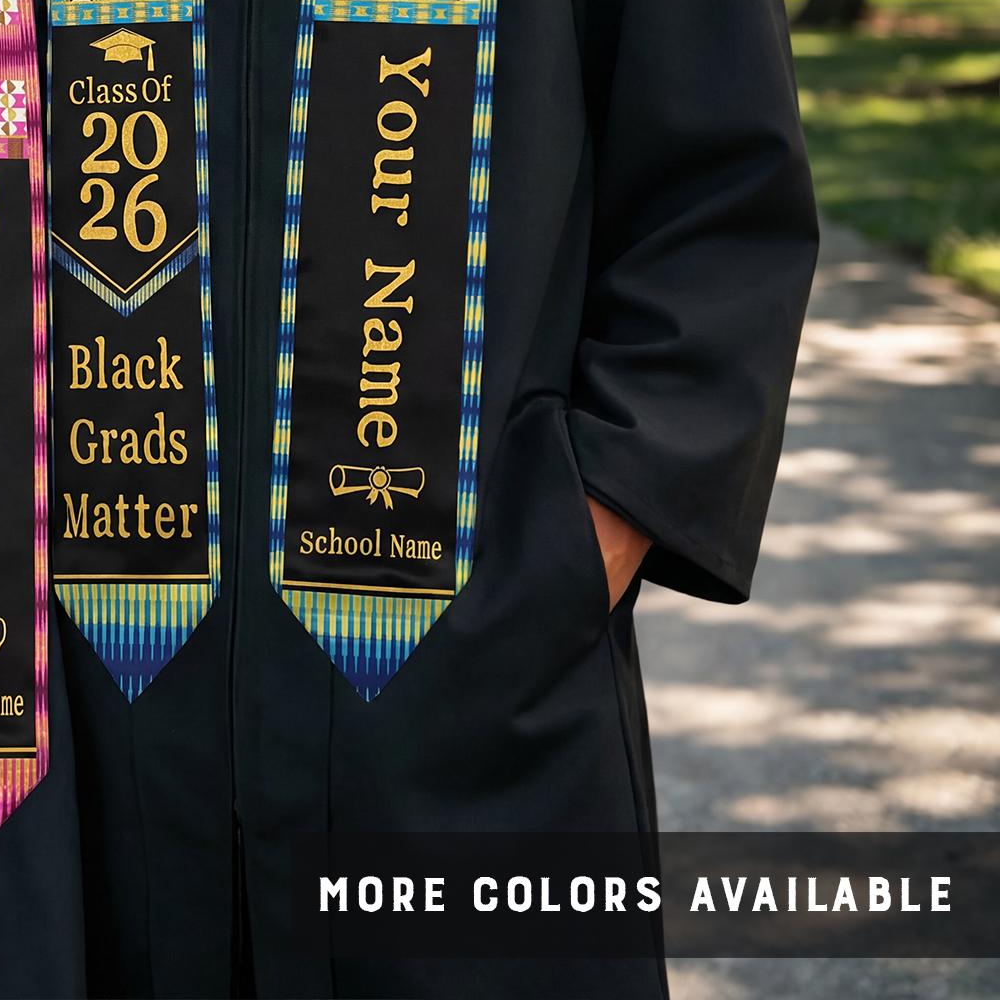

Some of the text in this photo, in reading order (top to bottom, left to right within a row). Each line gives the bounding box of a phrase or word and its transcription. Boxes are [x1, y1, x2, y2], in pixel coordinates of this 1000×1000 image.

[81, 111, 168, 173] 20
[80, 174, 166, 252] 26
[357, 47, 431, 447] Your Name
[68, 336, 183, 389] Black
[70, 412, 187, 464] Grads
[64, 494, 197, 538] Matter
[300, 527, 441, 560] School Name
